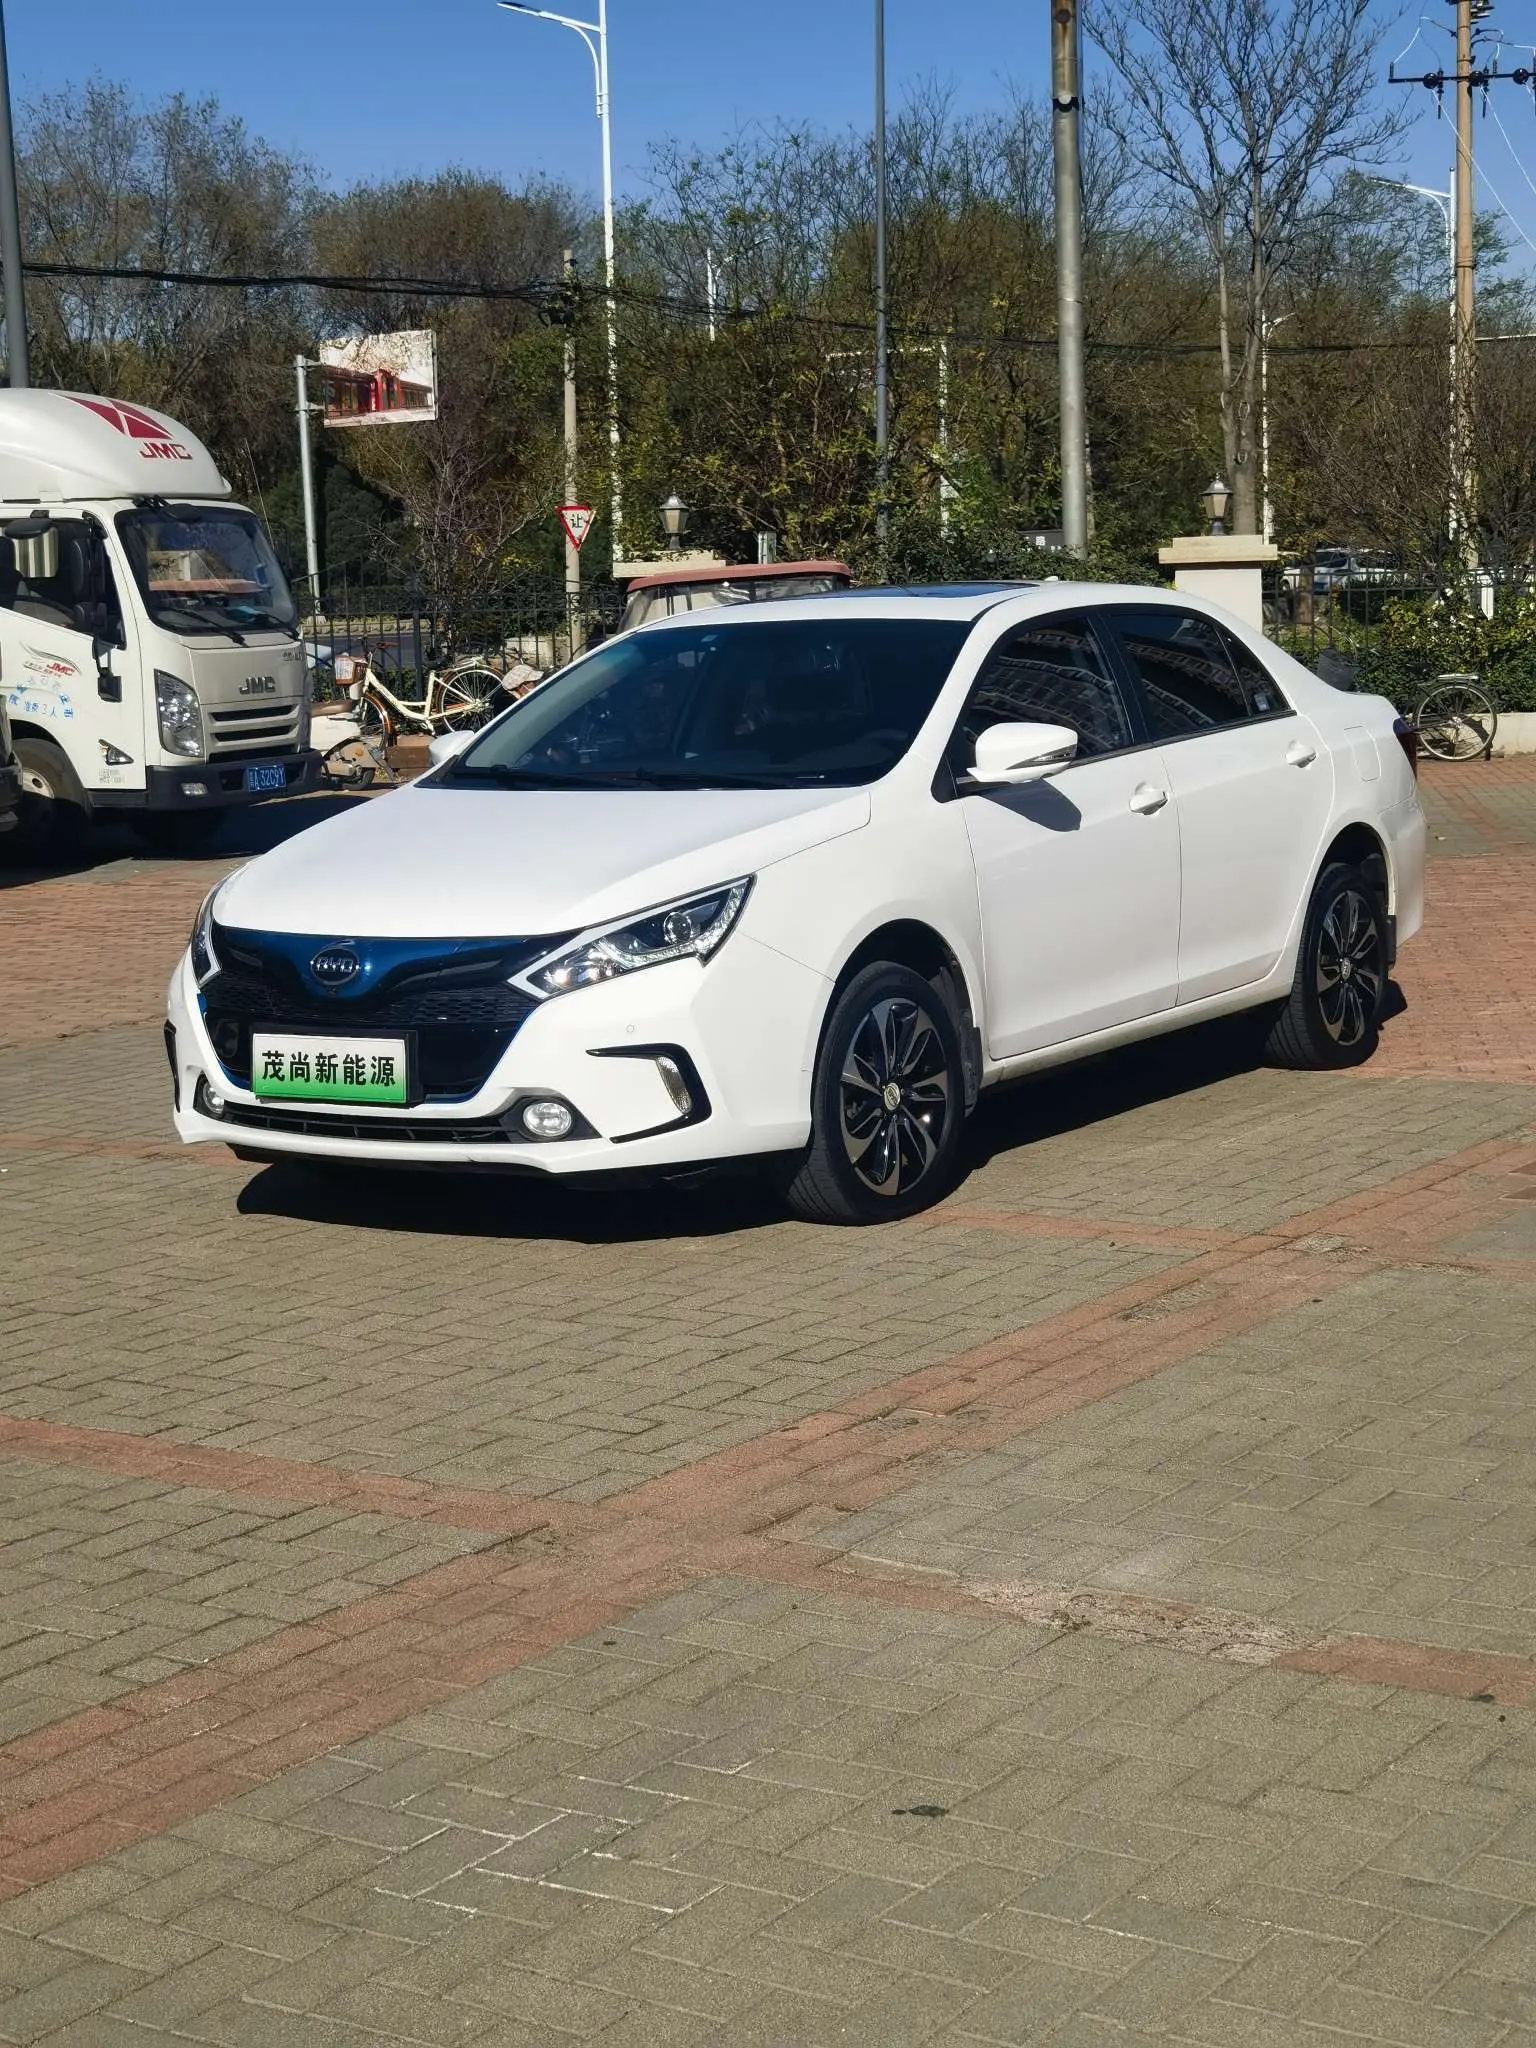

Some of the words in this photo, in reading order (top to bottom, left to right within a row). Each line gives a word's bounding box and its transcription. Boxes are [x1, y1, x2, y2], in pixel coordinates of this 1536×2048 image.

[139, 442, 193, 460] JMC
[570, 513, 583, 528] 让
[46, 662, 76, 677] JMC
[239, 676, 276, 695] JMC
[262, 1050, 396, 1087] 茂尚新能源
